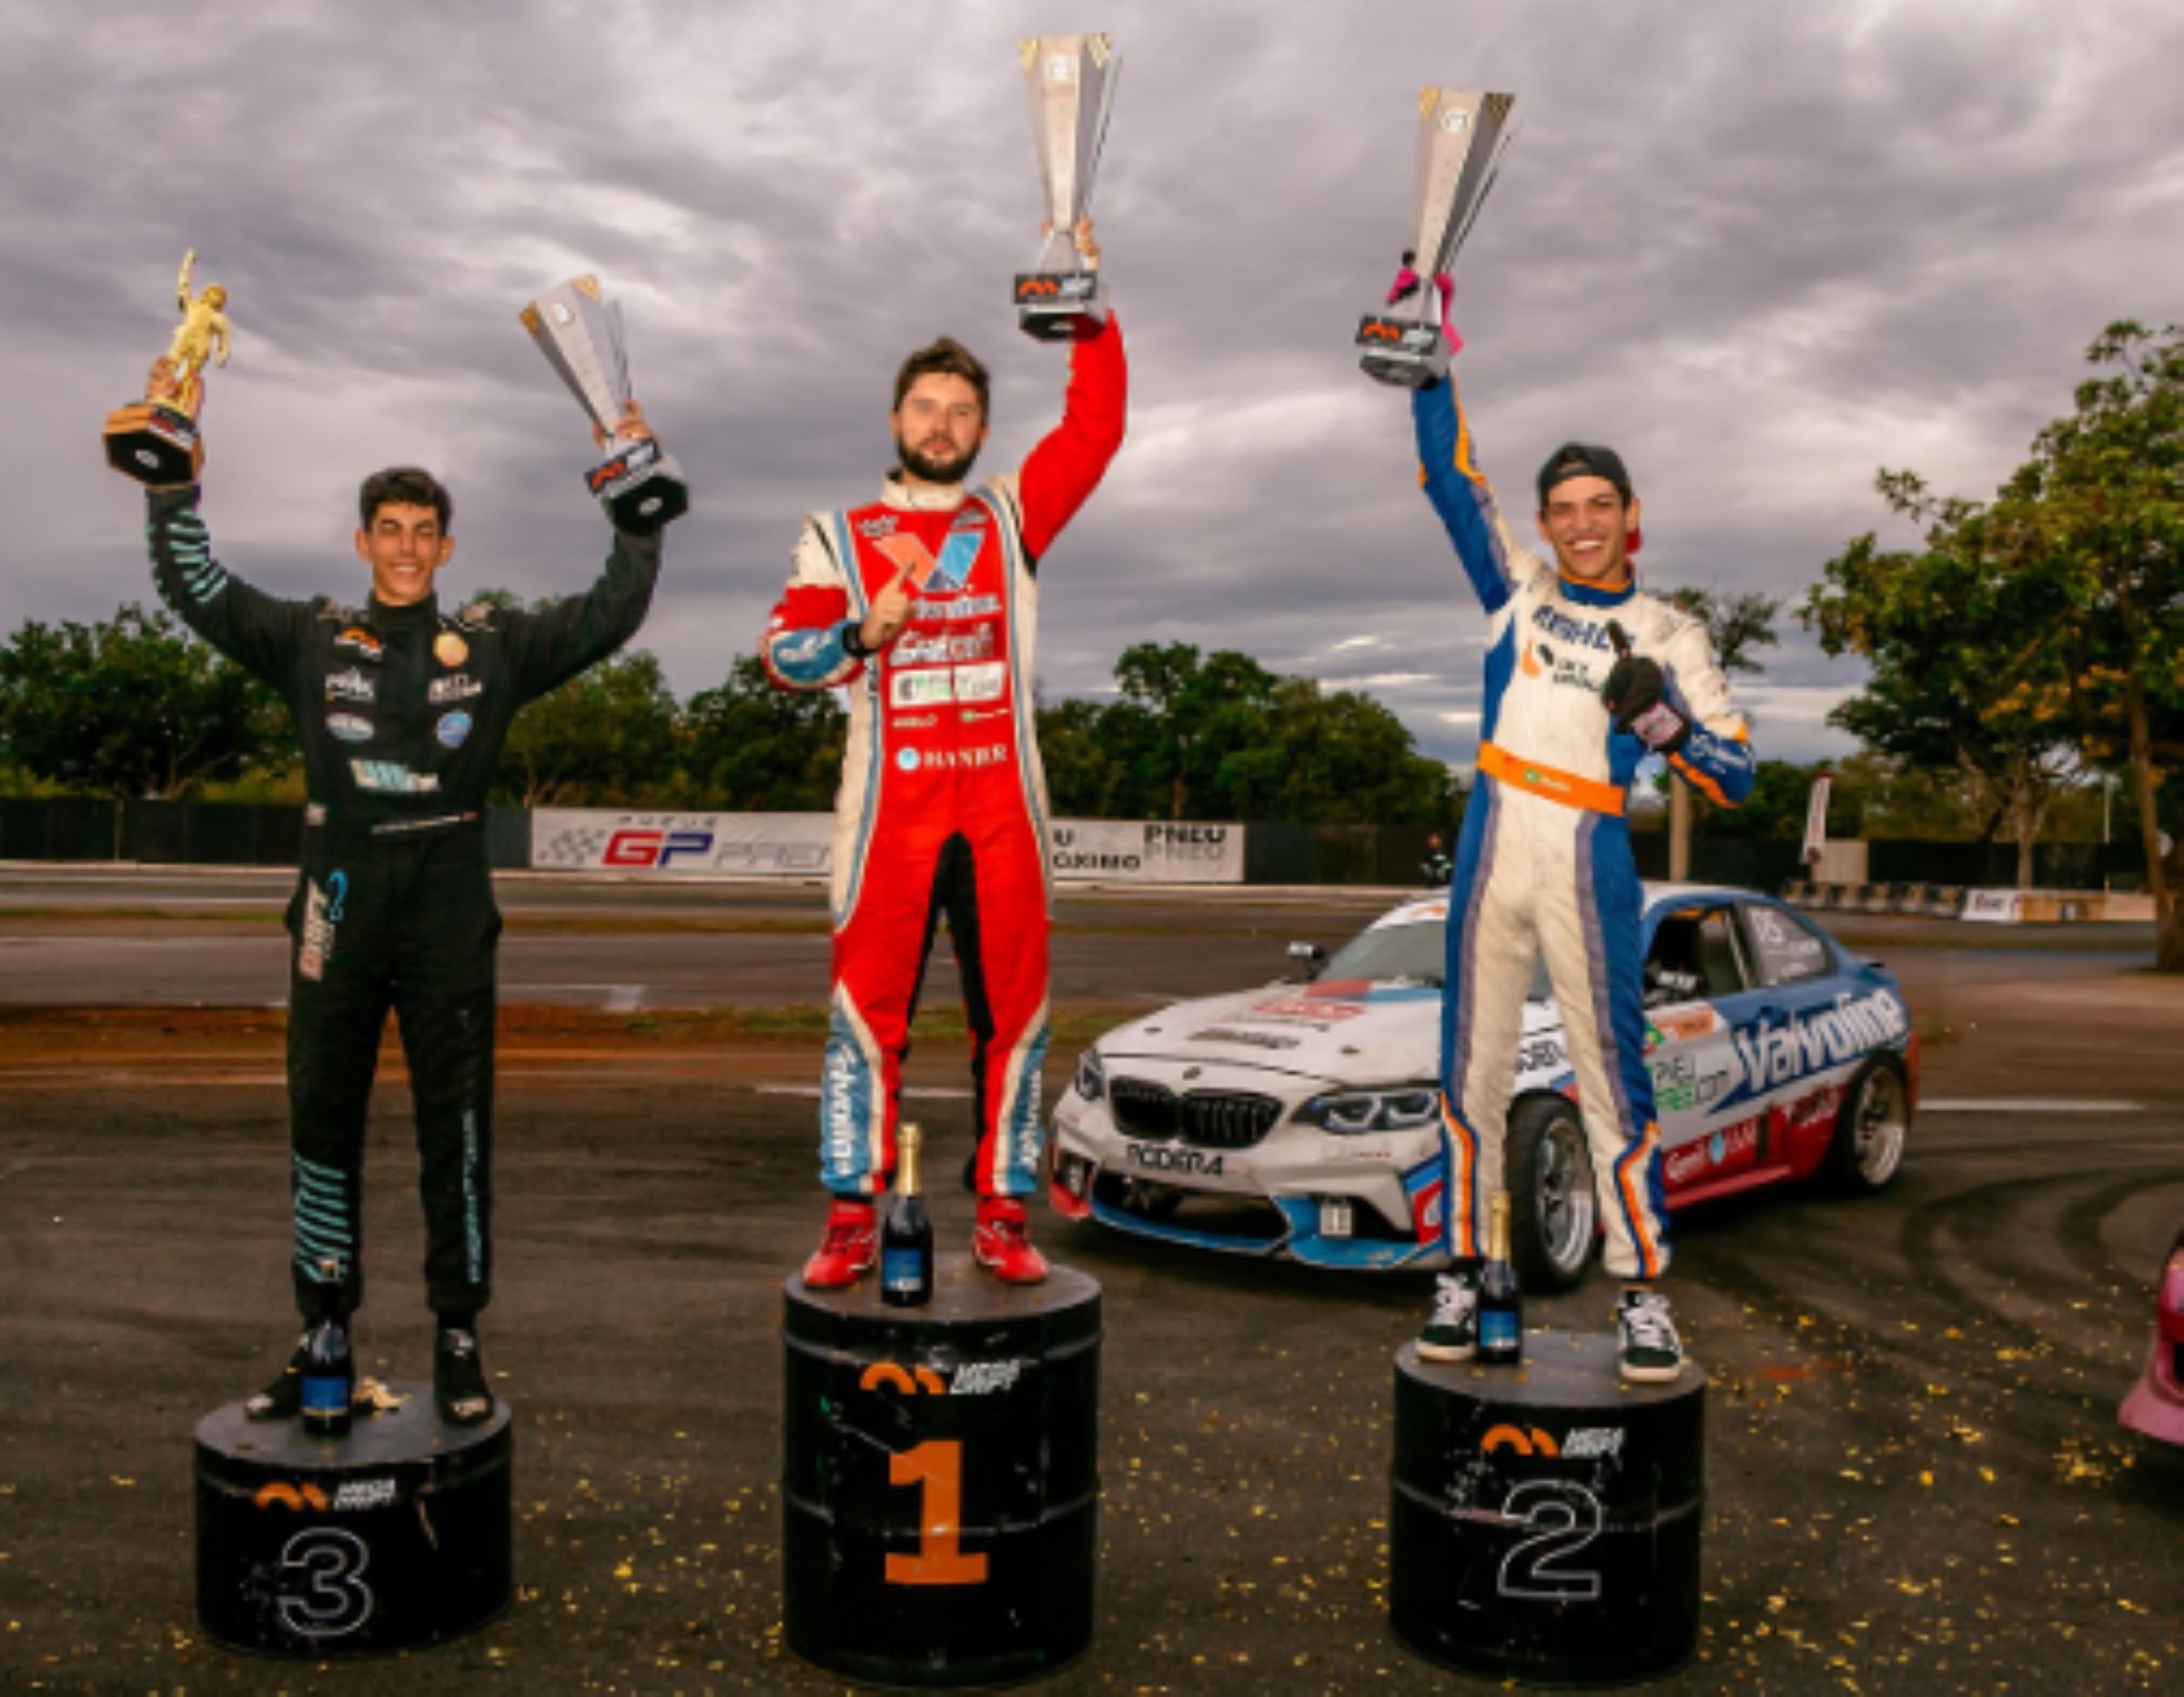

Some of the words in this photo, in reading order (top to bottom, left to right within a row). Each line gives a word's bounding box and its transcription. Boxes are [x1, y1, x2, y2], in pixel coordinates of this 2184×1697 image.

[602, 829, 715, 867] GP
[1143, 823, 1227, 843] PNEU
[1735, 988, 1906, 1092] Valvoline
[885, 1439, 988, 1584] 1
[1497, 1478, 1603, 1600] 2
[278, 1526, 375, 1637] 3
